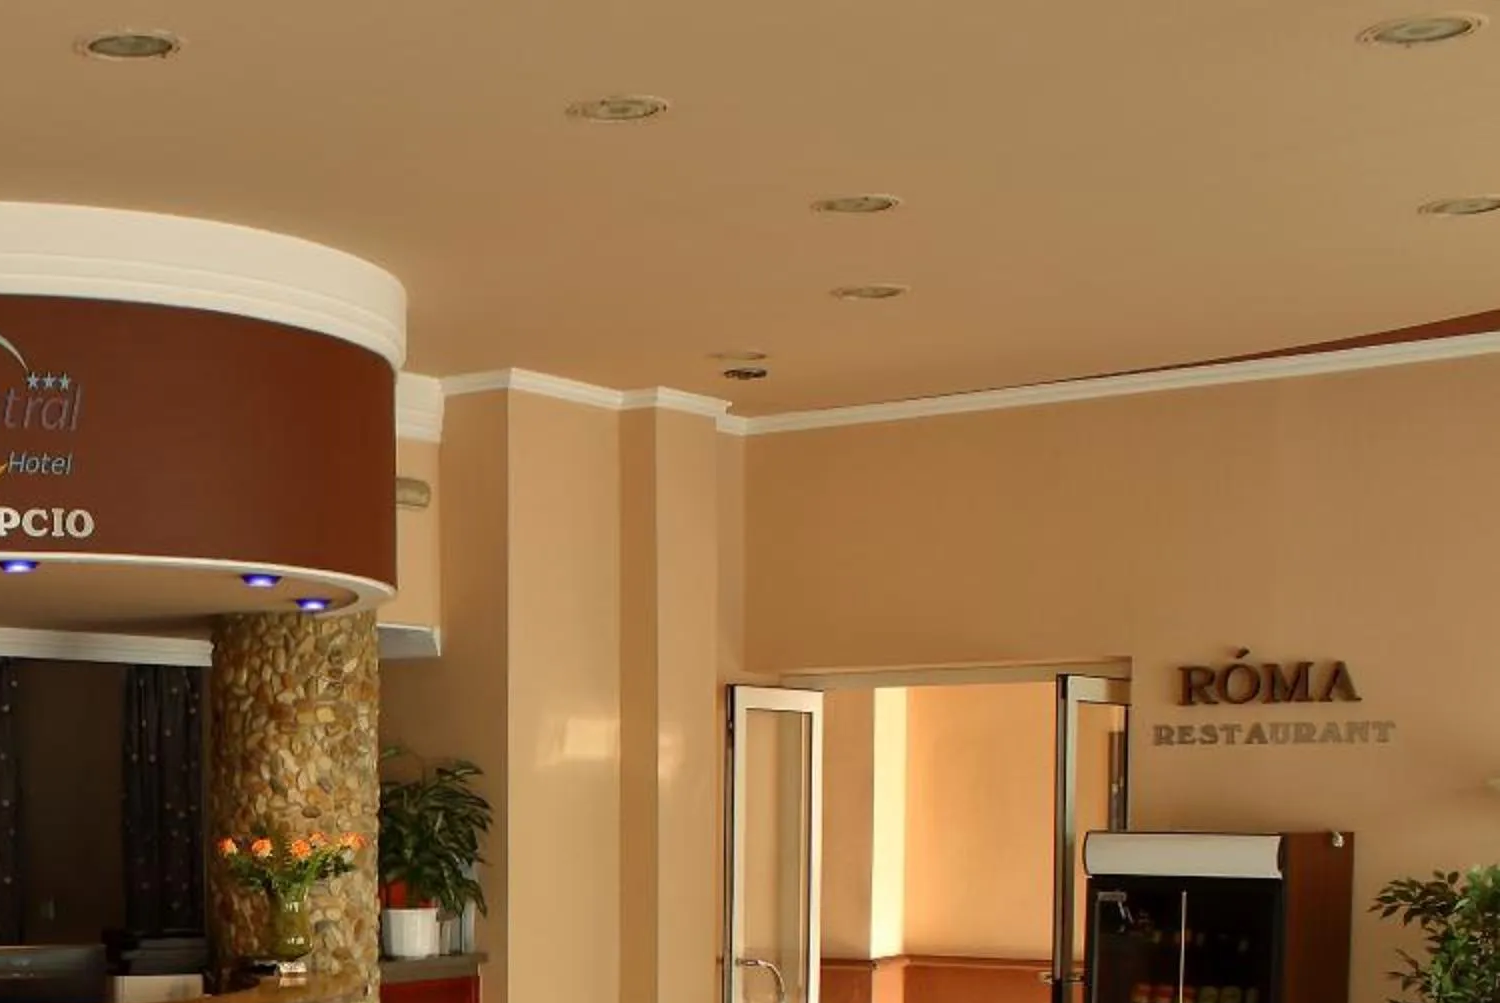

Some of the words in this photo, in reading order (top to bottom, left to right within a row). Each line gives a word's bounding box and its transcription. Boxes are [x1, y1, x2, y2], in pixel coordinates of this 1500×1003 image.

[7, 451, 73, 476] Hotel
[1176, 647, 1363, 706] RÓMA
[1152, 720, 1396, 747] RESTAURANT
